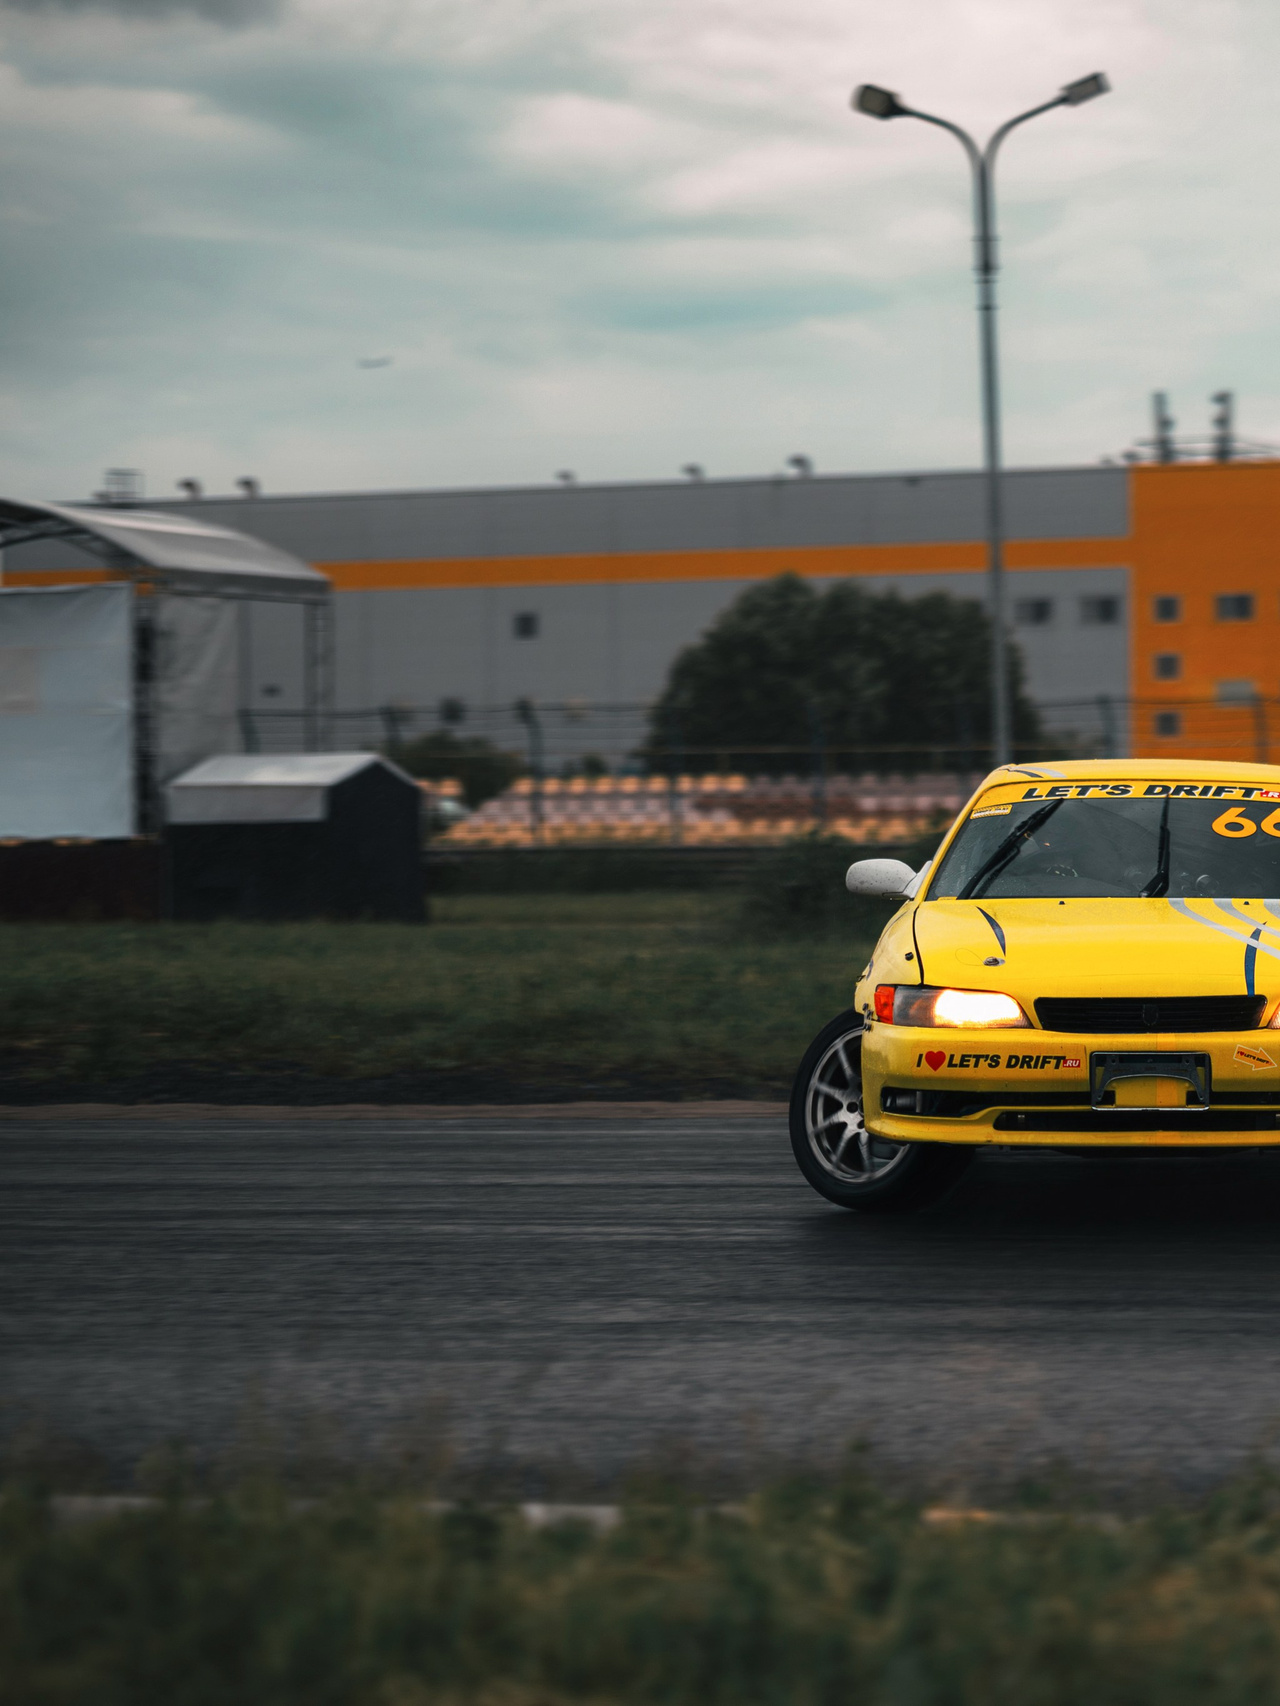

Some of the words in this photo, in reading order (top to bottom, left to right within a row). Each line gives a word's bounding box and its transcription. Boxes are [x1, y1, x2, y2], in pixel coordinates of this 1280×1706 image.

[1021, 784, 1132, 800] LET'S
[916, 1053, 923, 1068] I
[947, 1053, 1001, 1069] LET'S
